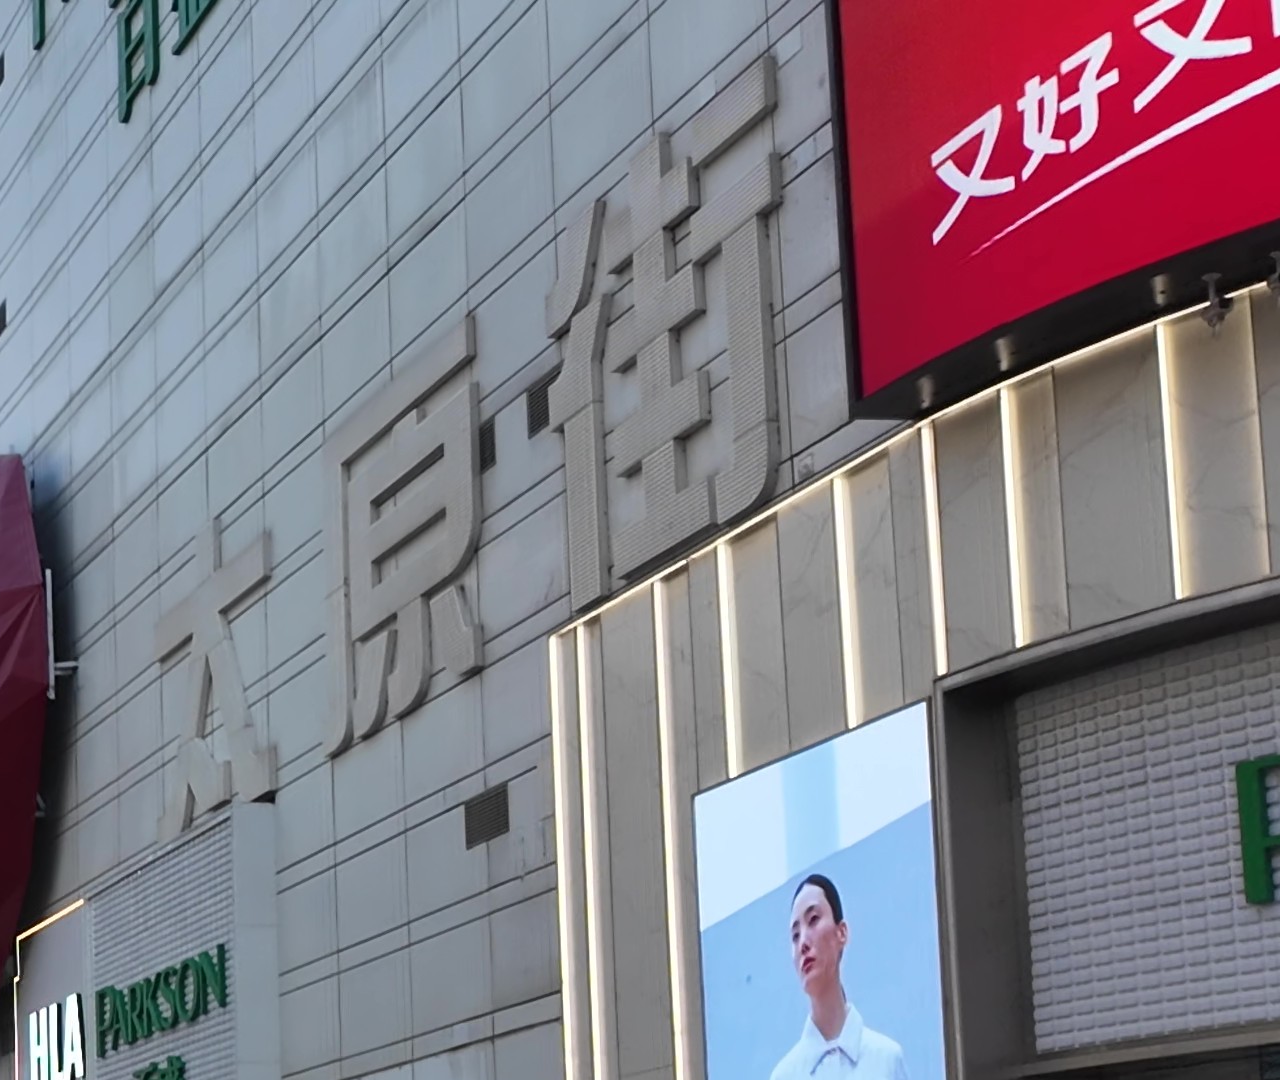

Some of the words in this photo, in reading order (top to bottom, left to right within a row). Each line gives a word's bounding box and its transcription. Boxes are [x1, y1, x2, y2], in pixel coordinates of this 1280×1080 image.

[931, 0, 1280, 246] 又好又
[156, 55, 782, 842] 太原街
[95, 944, 227, 1058] PARKSON
